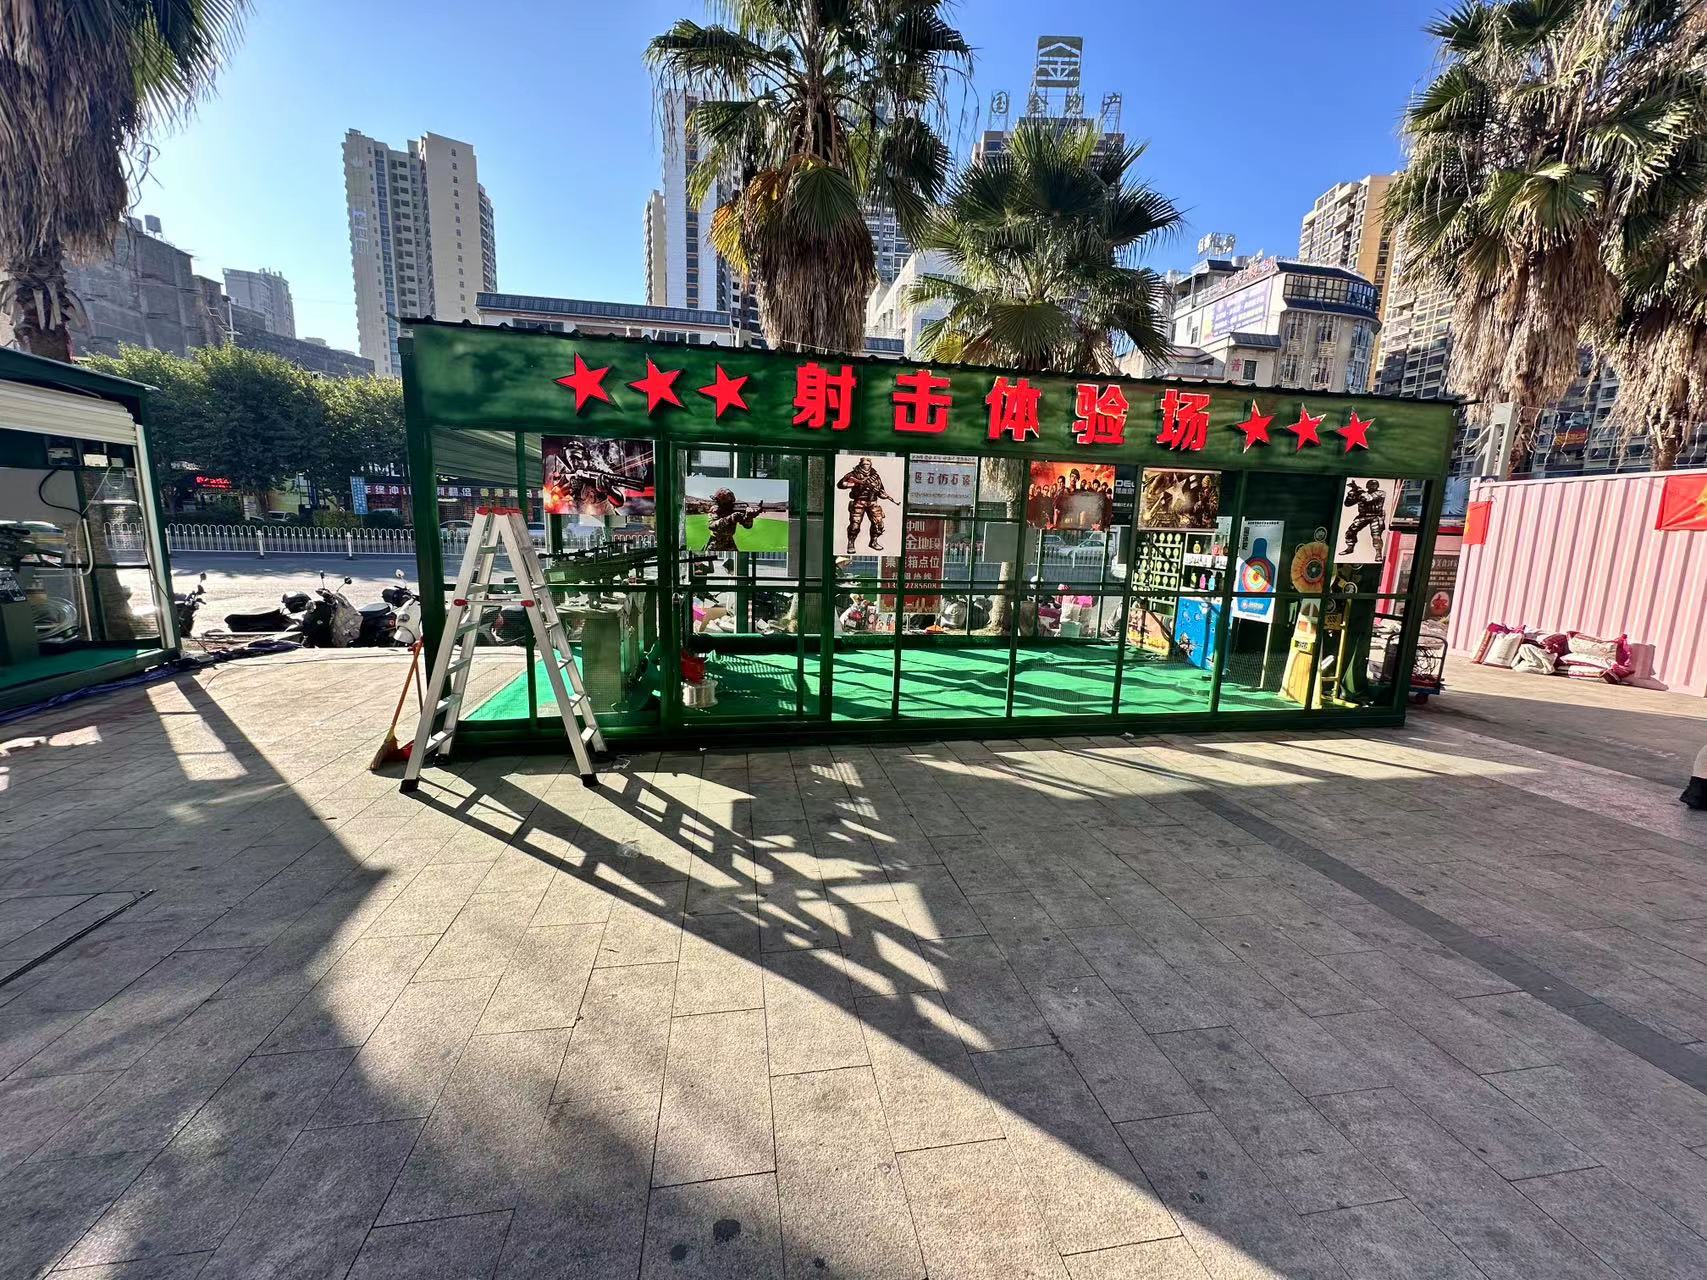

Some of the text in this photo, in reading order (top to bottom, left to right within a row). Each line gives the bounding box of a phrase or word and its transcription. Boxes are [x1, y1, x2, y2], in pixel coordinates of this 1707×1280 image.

[791, 362, 1211, 451] 射击体验场
[885, 555, 940, 569] 集箱点位
